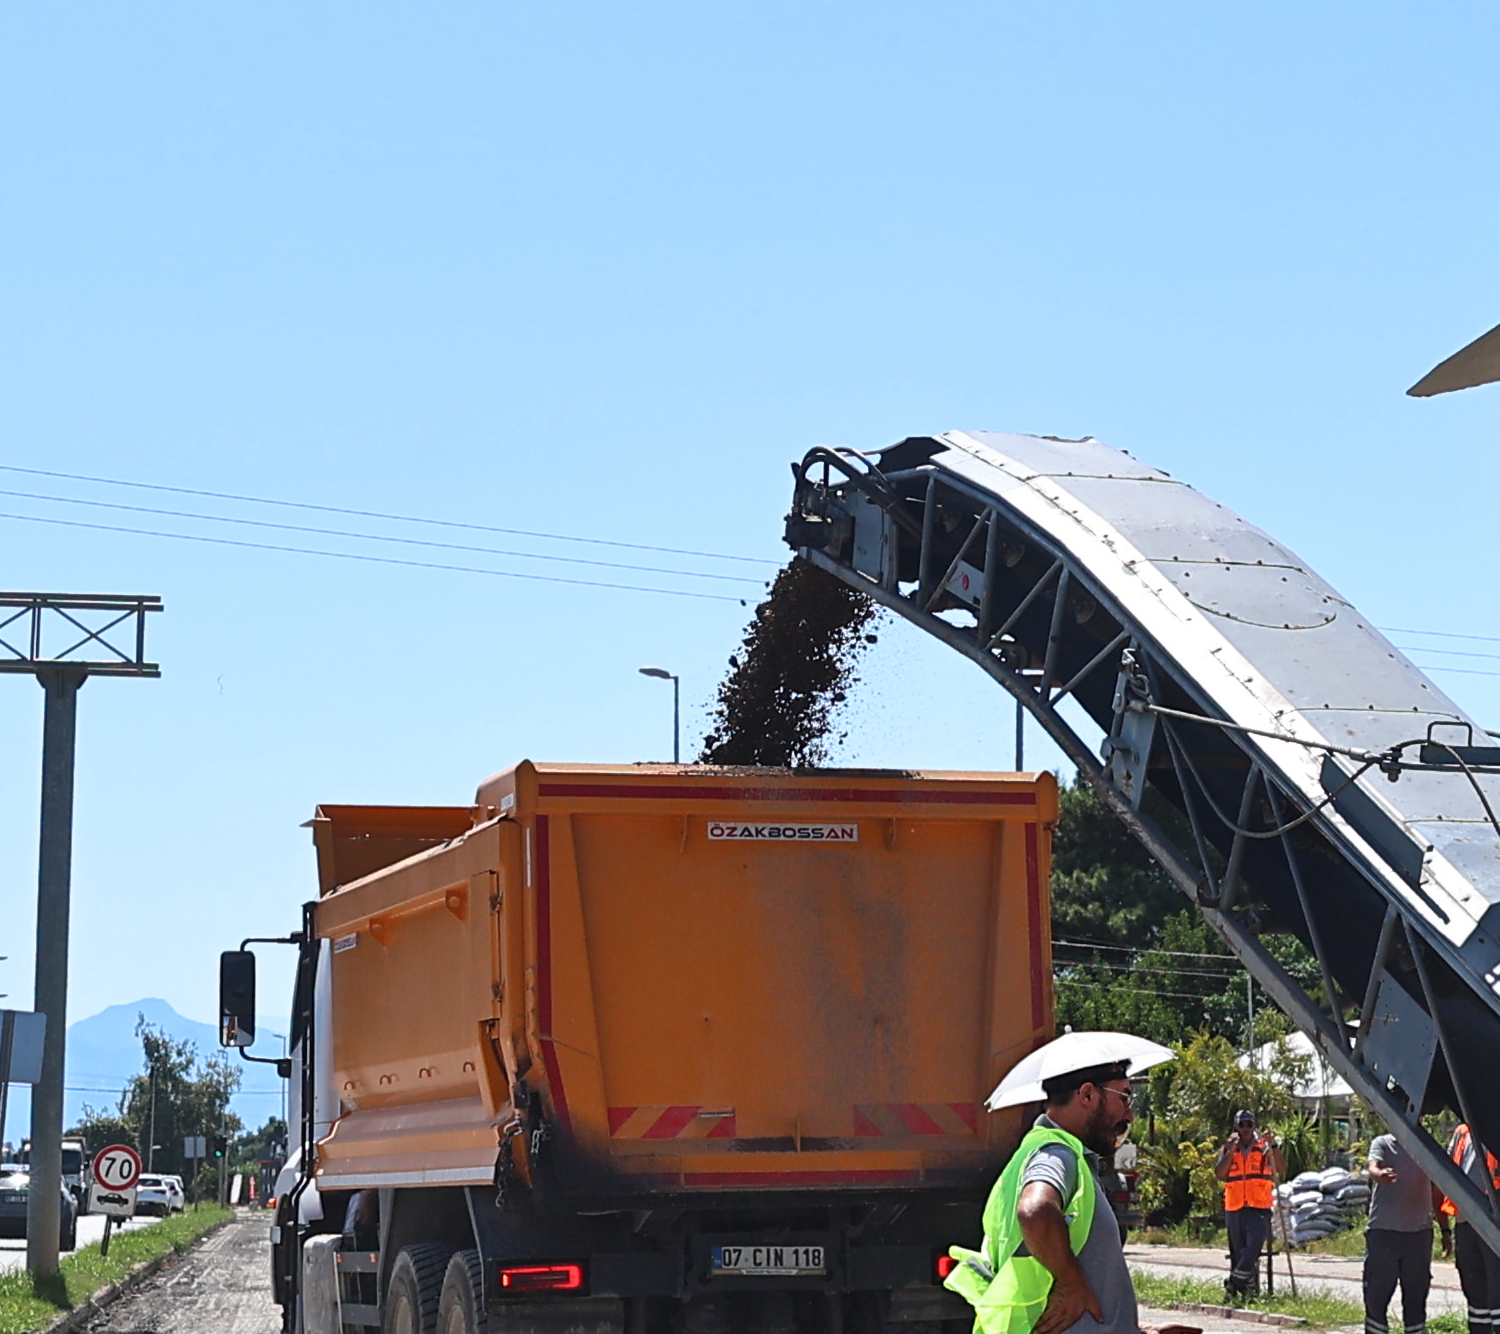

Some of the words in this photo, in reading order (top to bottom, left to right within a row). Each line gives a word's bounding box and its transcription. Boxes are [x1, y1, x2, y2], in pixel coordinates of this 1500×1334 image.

[710, 823, 854, 839] ÖZAKBOSSAN
[105, 1156, 133, 1179] 70
[723, 1248, 742, 1267] 07
[753, 1248, 783, 1267] CIN
[792, 1248, 821, 1267] 118
